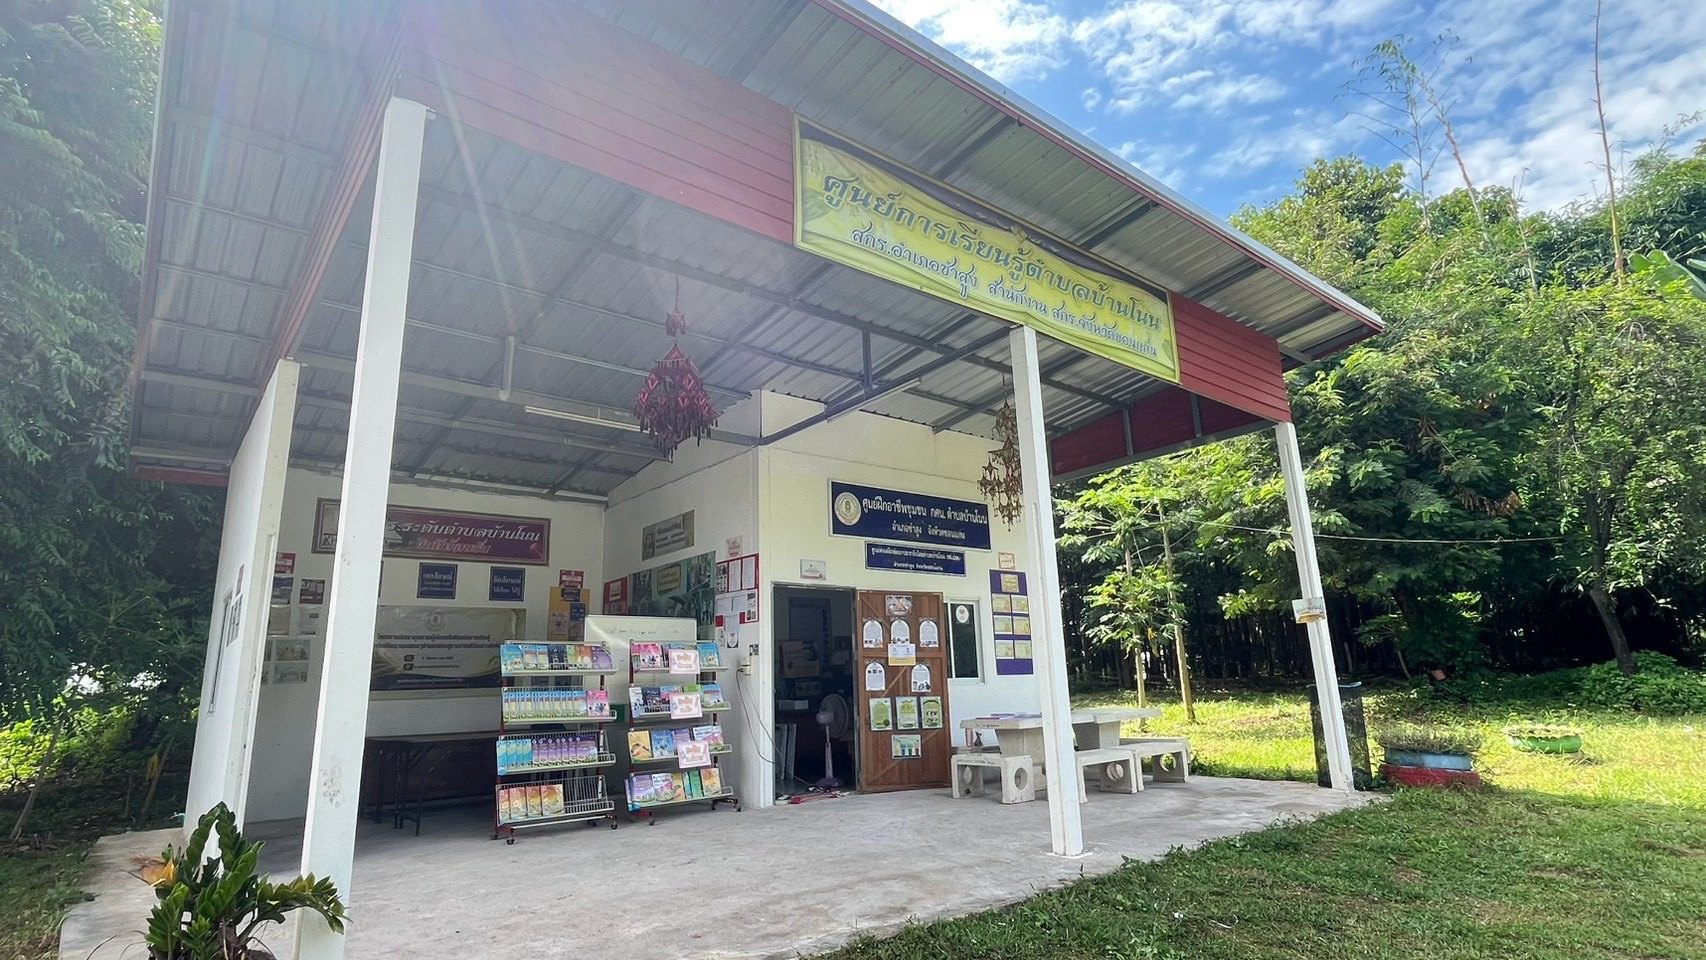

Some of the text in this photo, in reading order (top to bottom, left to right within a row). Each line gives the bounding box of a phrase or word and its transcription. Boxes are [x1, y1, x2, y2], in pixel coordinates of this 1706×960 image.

[823, 175, 1161, 330] ศูนย์การเรียนรู้ตำบลบ้านโนน
[988, 275, 1048, 315] สำนักงาน
